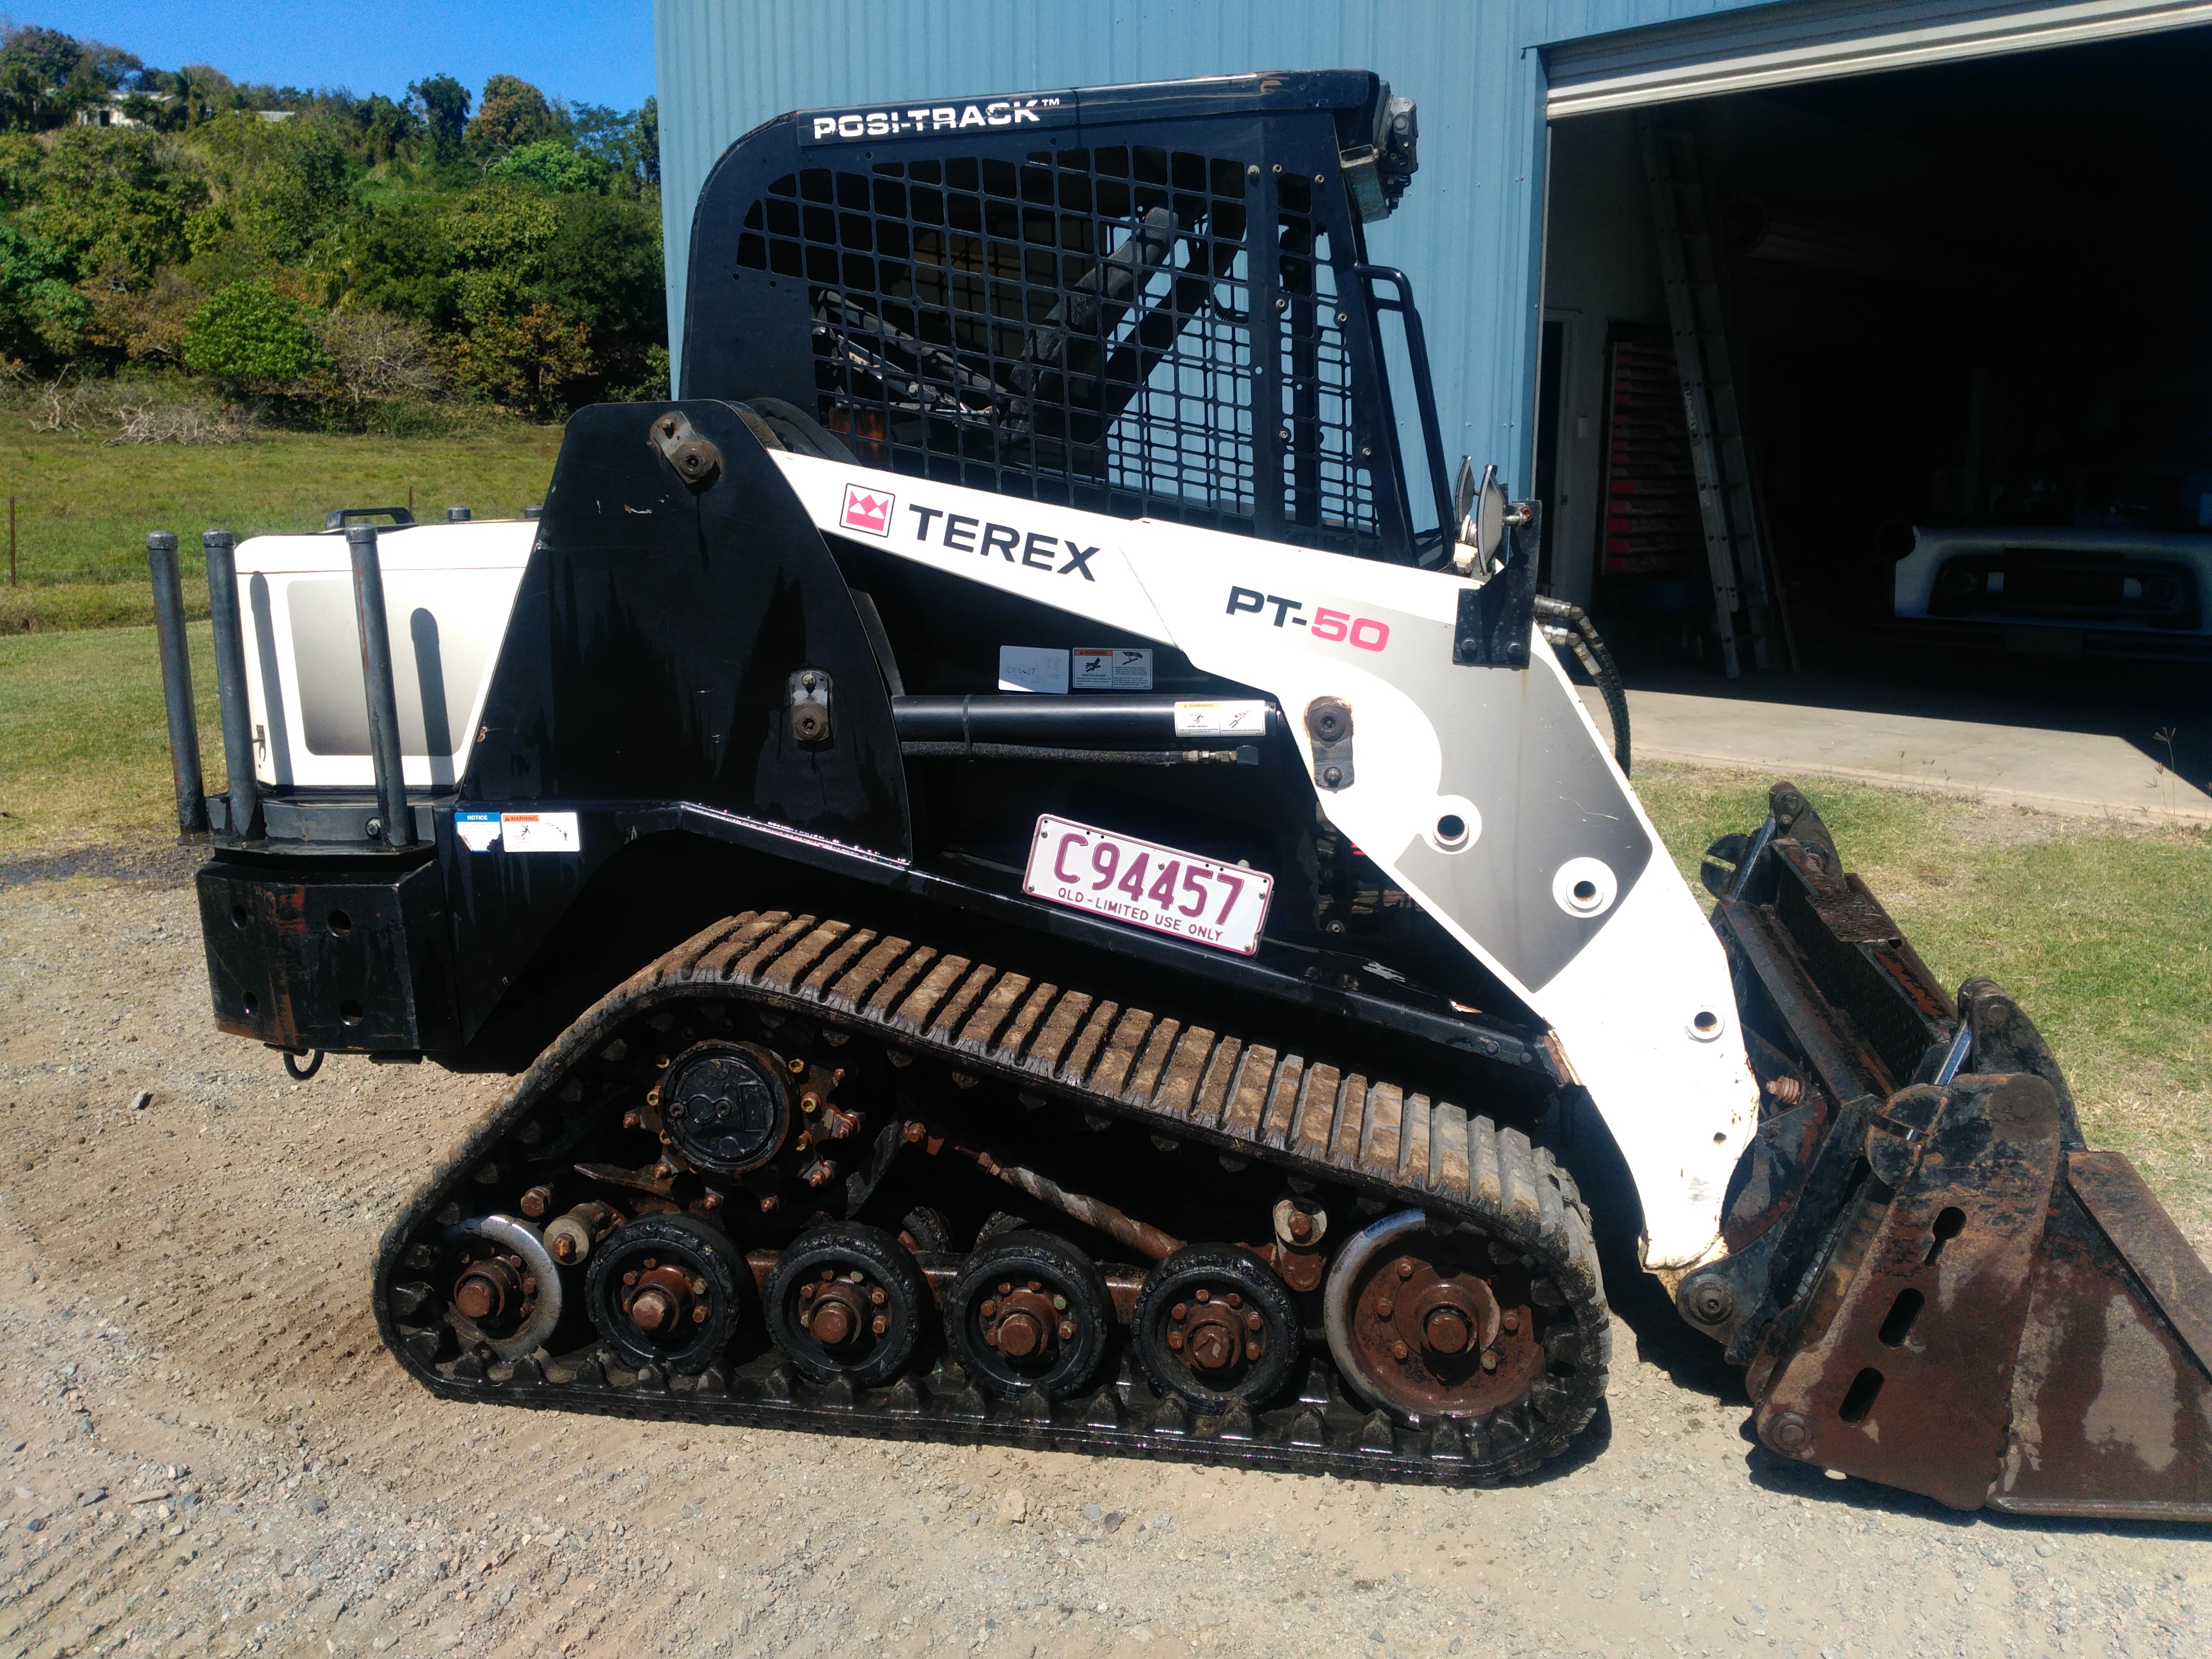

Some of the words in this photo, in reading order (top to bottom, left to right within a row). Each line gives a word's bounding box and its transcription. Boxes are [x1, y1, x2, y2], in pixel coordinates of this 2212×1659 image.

[909, 504, 1101, 582] TEREX
[1225, 585, 1390, 652] PT-50
[1053, 832, 1245, 925] C94457
[1155, 913, 1182, 930] USE
[1189, 923, 1223, 941] ONLY
